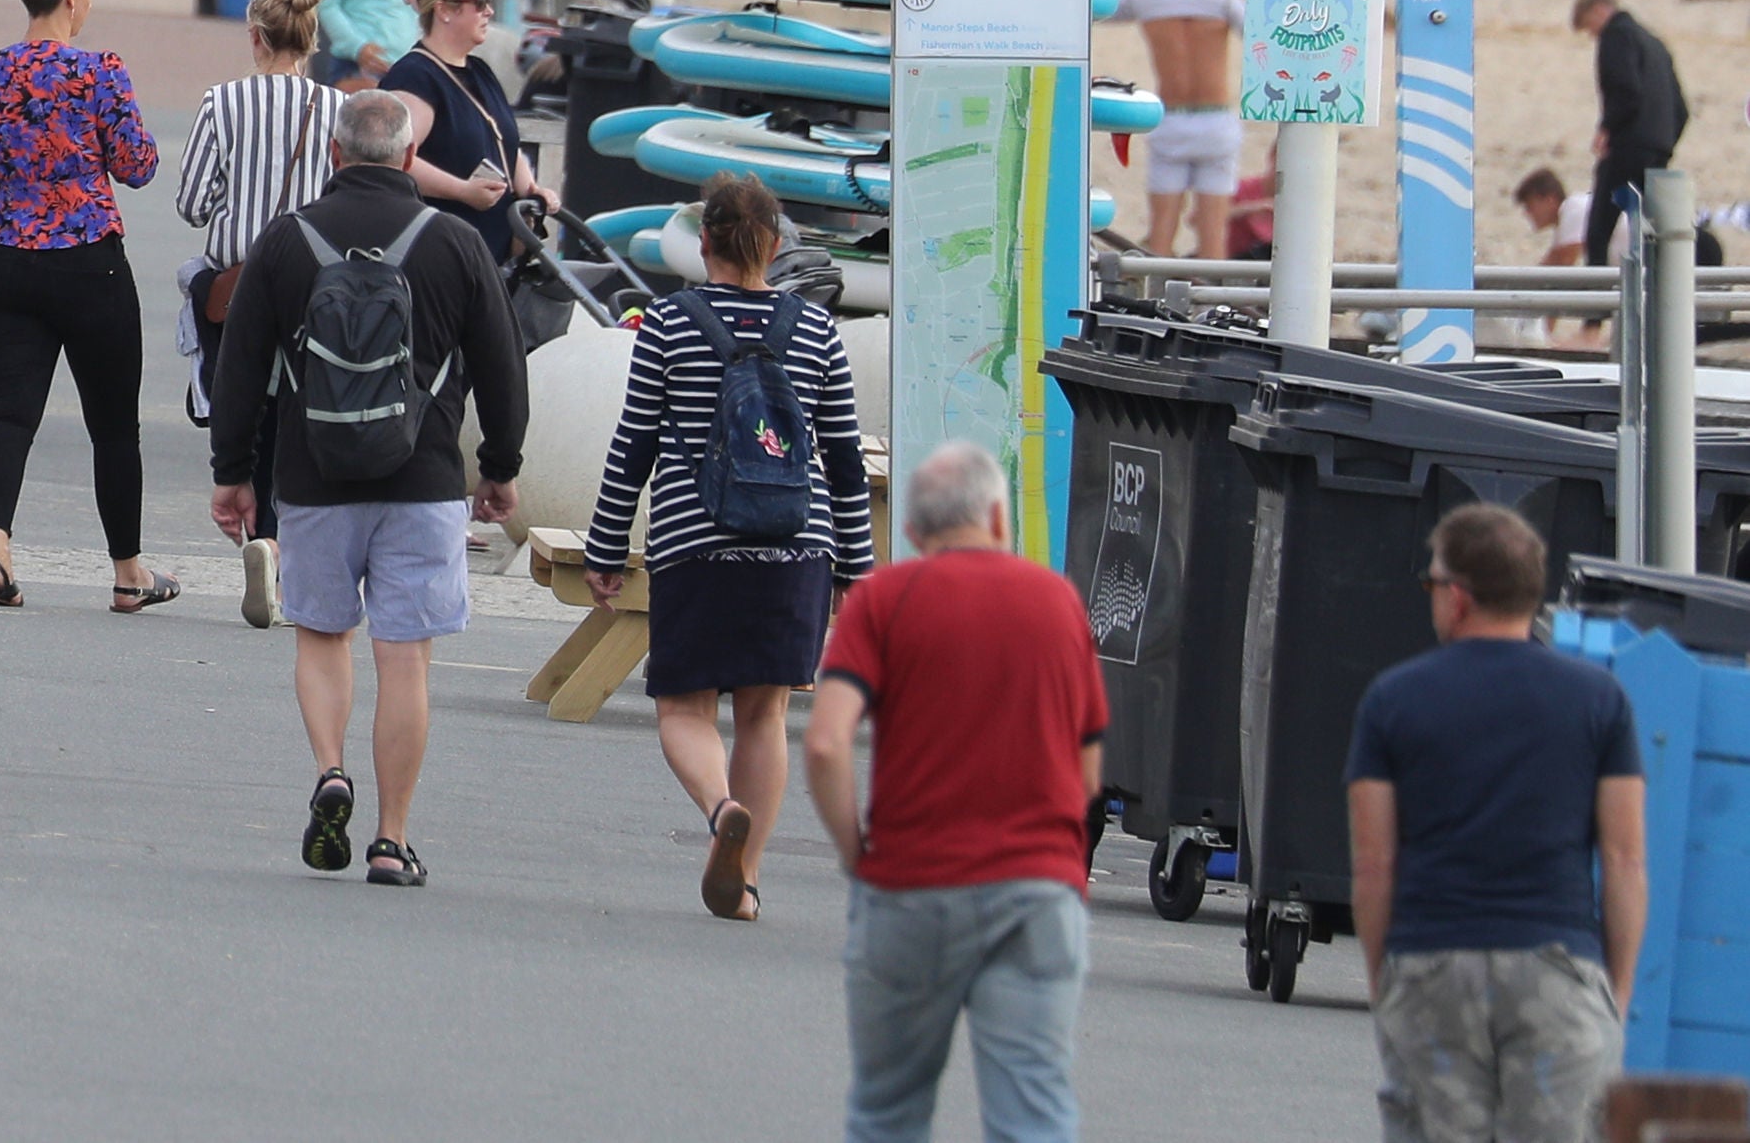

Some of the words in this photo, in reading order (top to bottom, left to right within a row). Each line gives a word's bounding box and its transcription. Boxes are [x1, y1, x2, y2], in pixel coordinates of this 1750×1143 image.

[921, 22, 954, 33] Manor
[956, 22, 984, 35] Steps
[987, 22, 1018, 33] Beach
[1282, 1, 1330, 32] Only
[921, 40, 981, 50] Fisherman's
[983, 40, 1009, 50] Walk
[1012, 40, 1043, 51] Beach
[1269, 23, 1346, 51] FOOTPRINTS
[1113, 460, 1145, 506] BCP
[1109, 506, 1142, 536] Council
